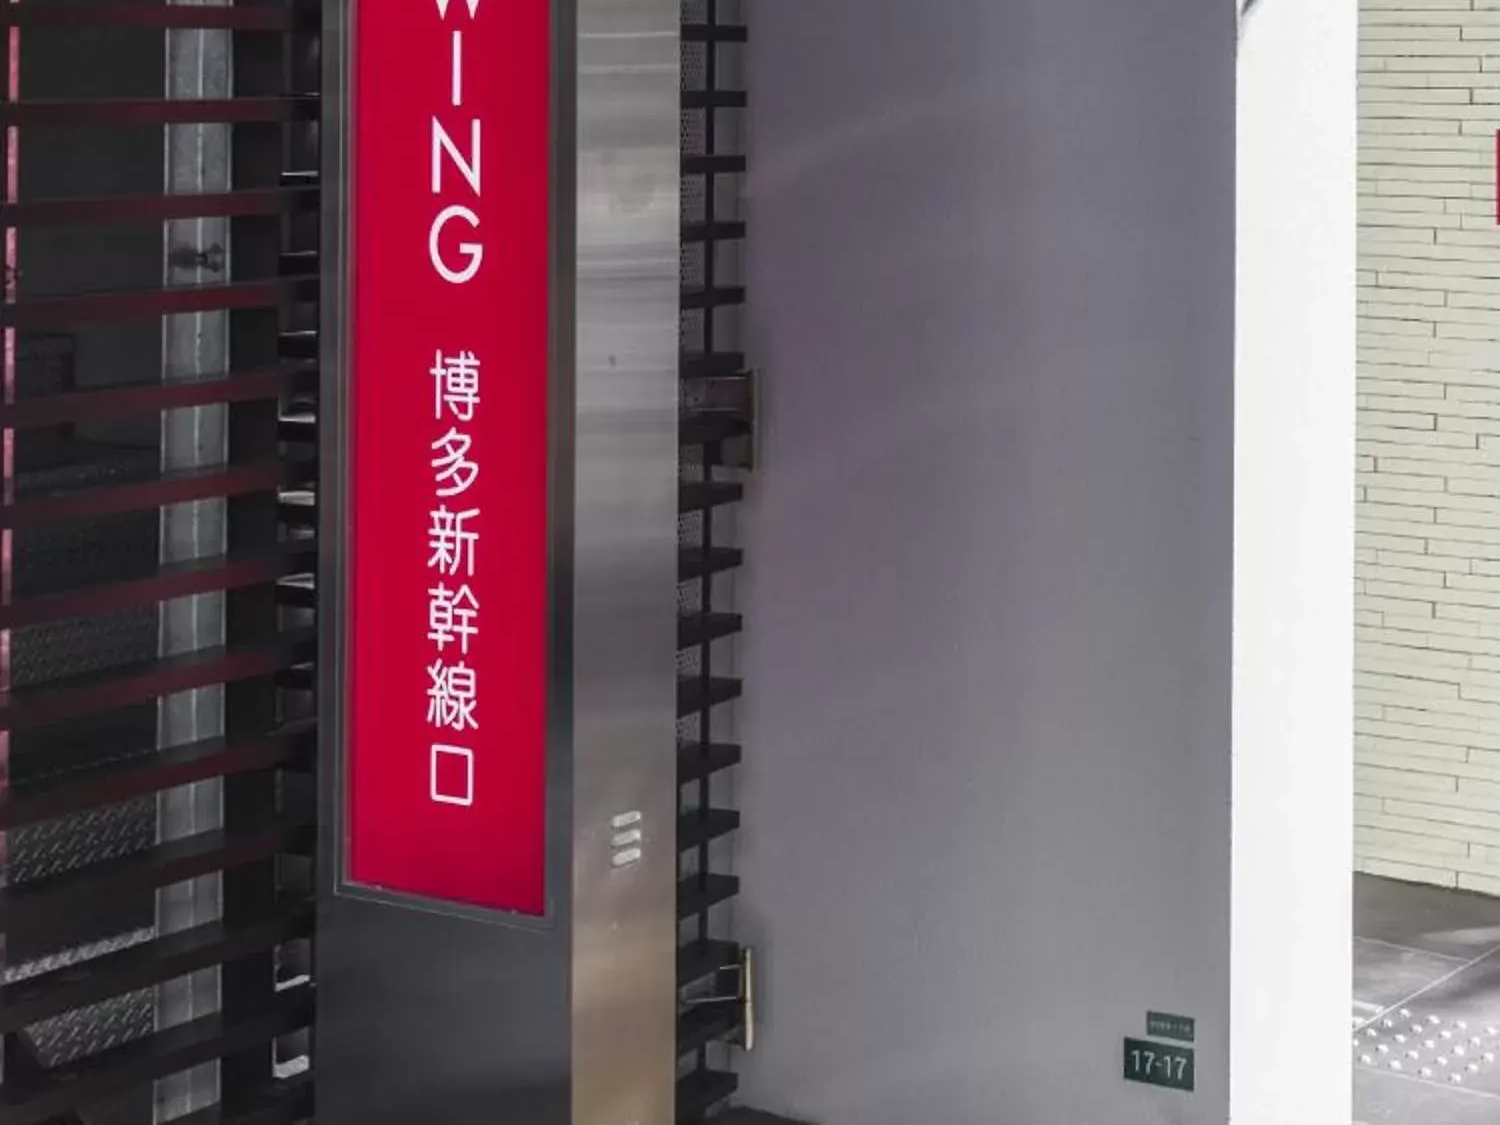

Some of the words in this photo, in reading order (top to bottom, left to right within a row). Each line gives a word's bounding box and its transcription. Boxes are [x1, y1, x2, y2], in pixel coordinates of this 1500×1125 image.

[426, 349, 481, 807] 博多新幹線口
[1131, 1049, 1188, 1081] 17-17
